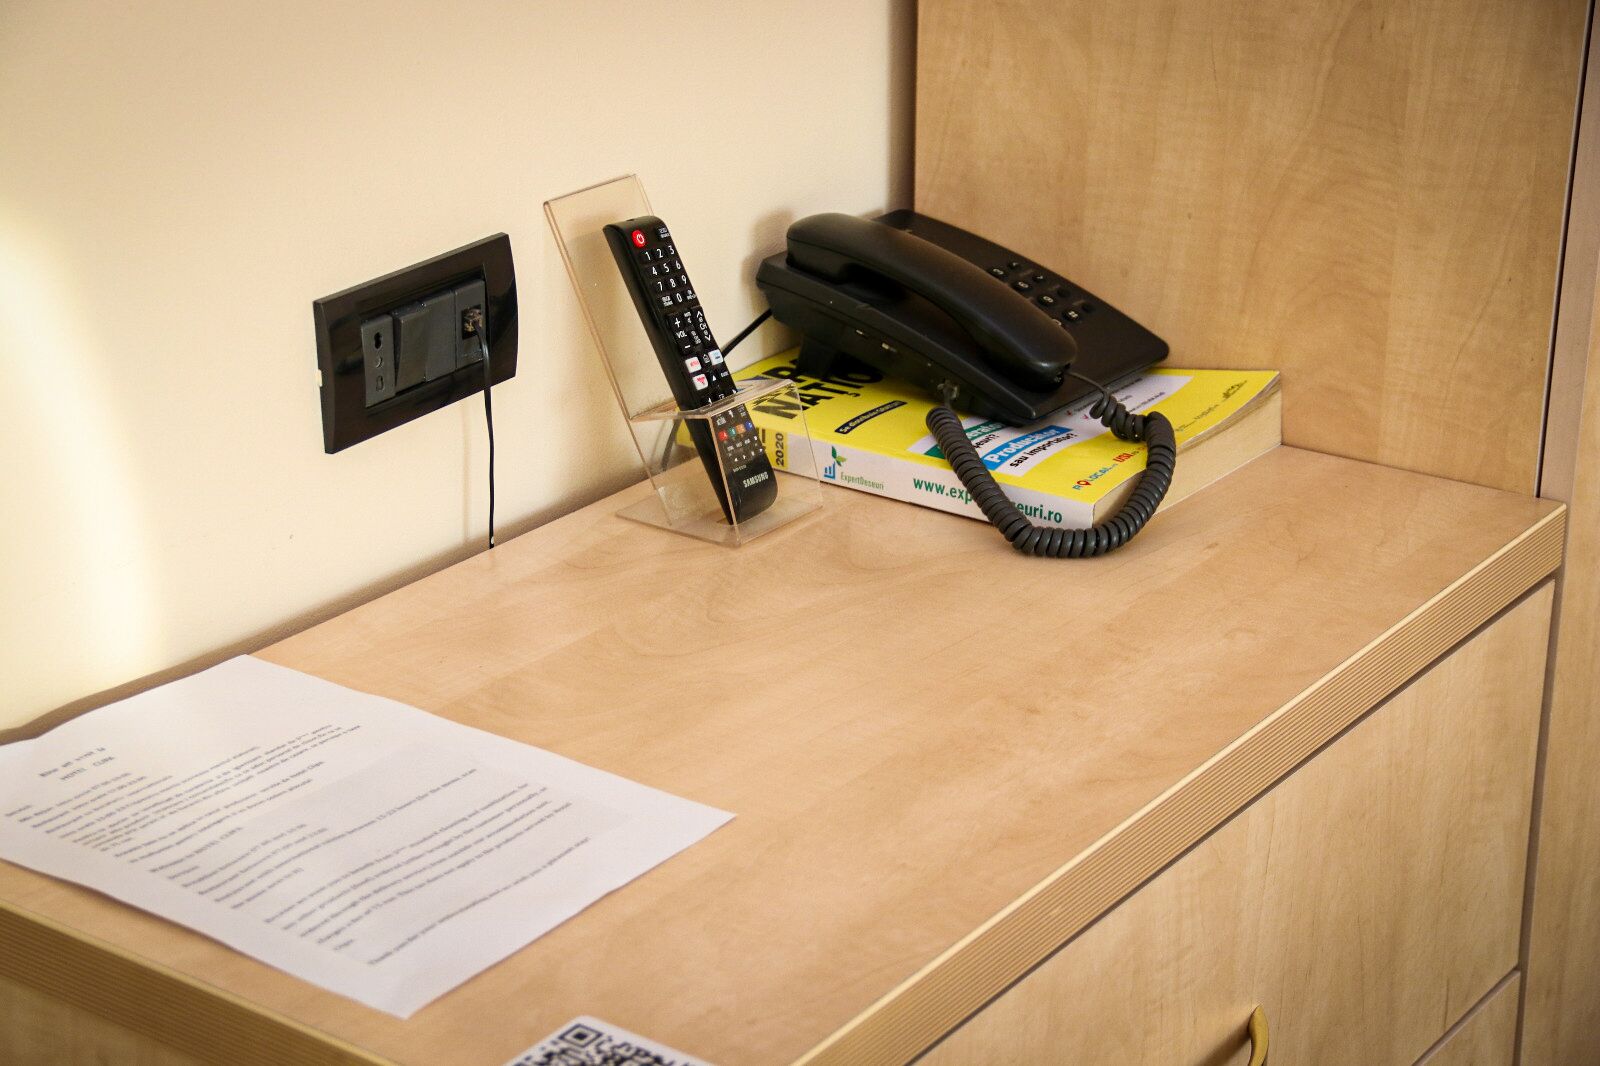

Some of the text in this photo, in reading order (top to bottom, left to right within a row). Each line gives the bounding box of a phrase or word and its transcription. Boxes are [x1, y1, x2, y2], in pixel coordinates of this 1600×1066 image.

[645, 245, 675, 260] 1 2 3
[652, 260, 681, 276] 4 5 6
[657, 274, 687, 291] 7 8 9
[775, 432, 785, 467] 2020
[742, 471, 769, 488] SAMSUNG
